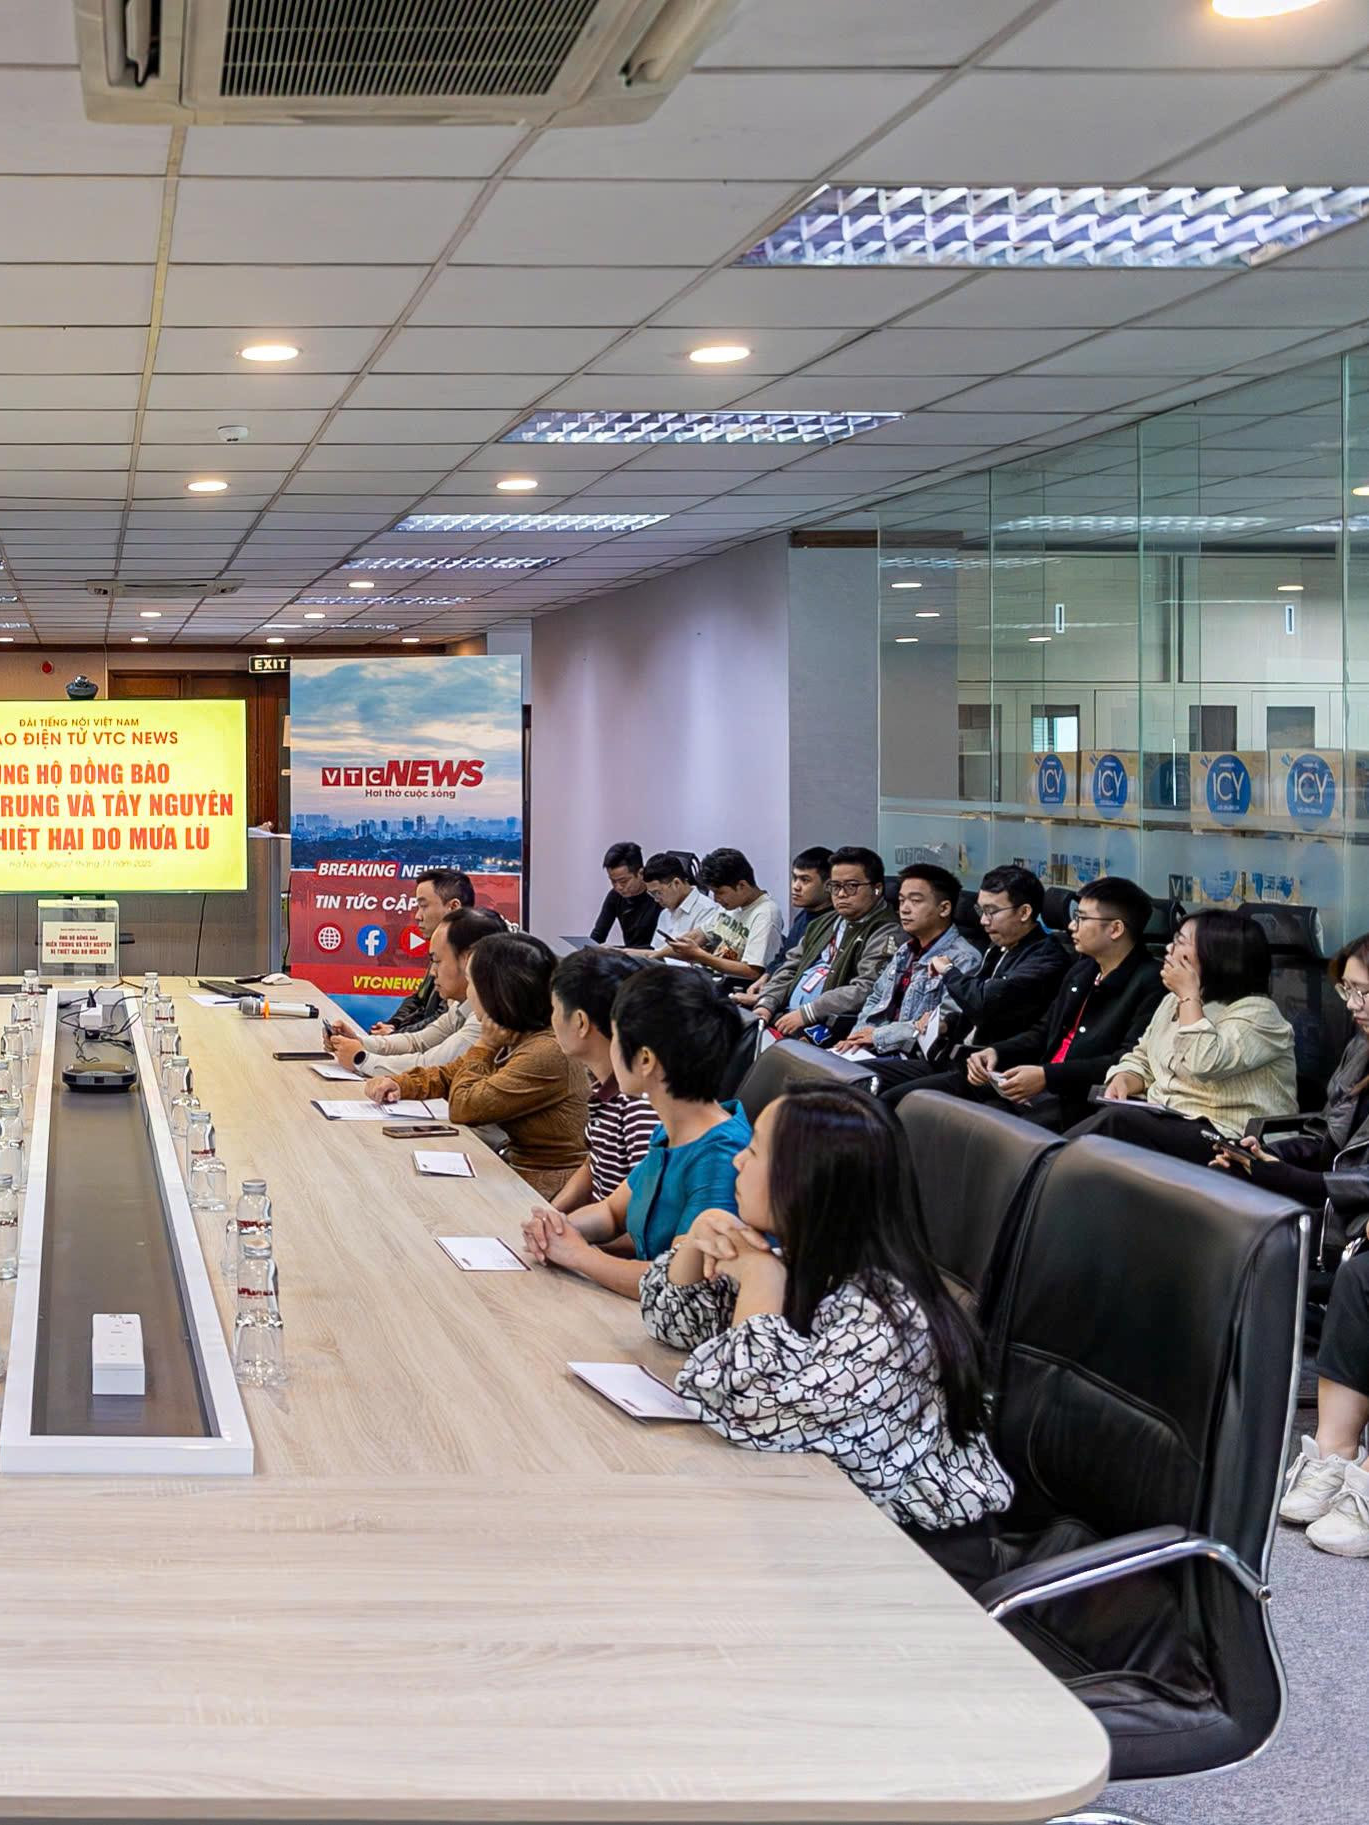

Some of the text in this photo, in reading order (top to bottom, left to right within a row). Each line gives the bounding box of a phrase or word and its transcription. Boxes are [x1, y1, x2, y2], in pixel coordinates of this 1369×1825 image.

[254, 658, 287, 670] EXIT
[19, 715, 139, 728] ĐÀI TIẾNG NÓI VIỆT NAM
[23, 729, 62, 750] ĐIỆN
[67, 727, 88, 745] TỬ
[93, 731, 126, 745] VTC
[132, 731, 178, 745] NEWS
[36, 760, 63, 789] HỘ
[70, 756, 124, 785] ĐỒNG
[131, 760, 170, 784] BÀO
[1041, 768, 1063, 794] ICY
[1097, 769, 1124, 798] ICY
[404, 789, 429, 799] cuộc
[1212, 771, 1245, 801] ICY
[1293, 769, 1329, 804] ICY
[67, 790, 96, 817] VÀ
[102, 790, 142, 817] TÂY
[149, 789, 233, 817] NGUYÊN
[48, 827, 84, 855] HẠI
[92, 827, 121, 851] DO
[129, 823, 178, 850] MƯA
[185, 824, 210, 850] LŨ
[318, 862, 448, 878] BREAKING NE
[315, 892, 419, 915] TIN TỨC CẬP
